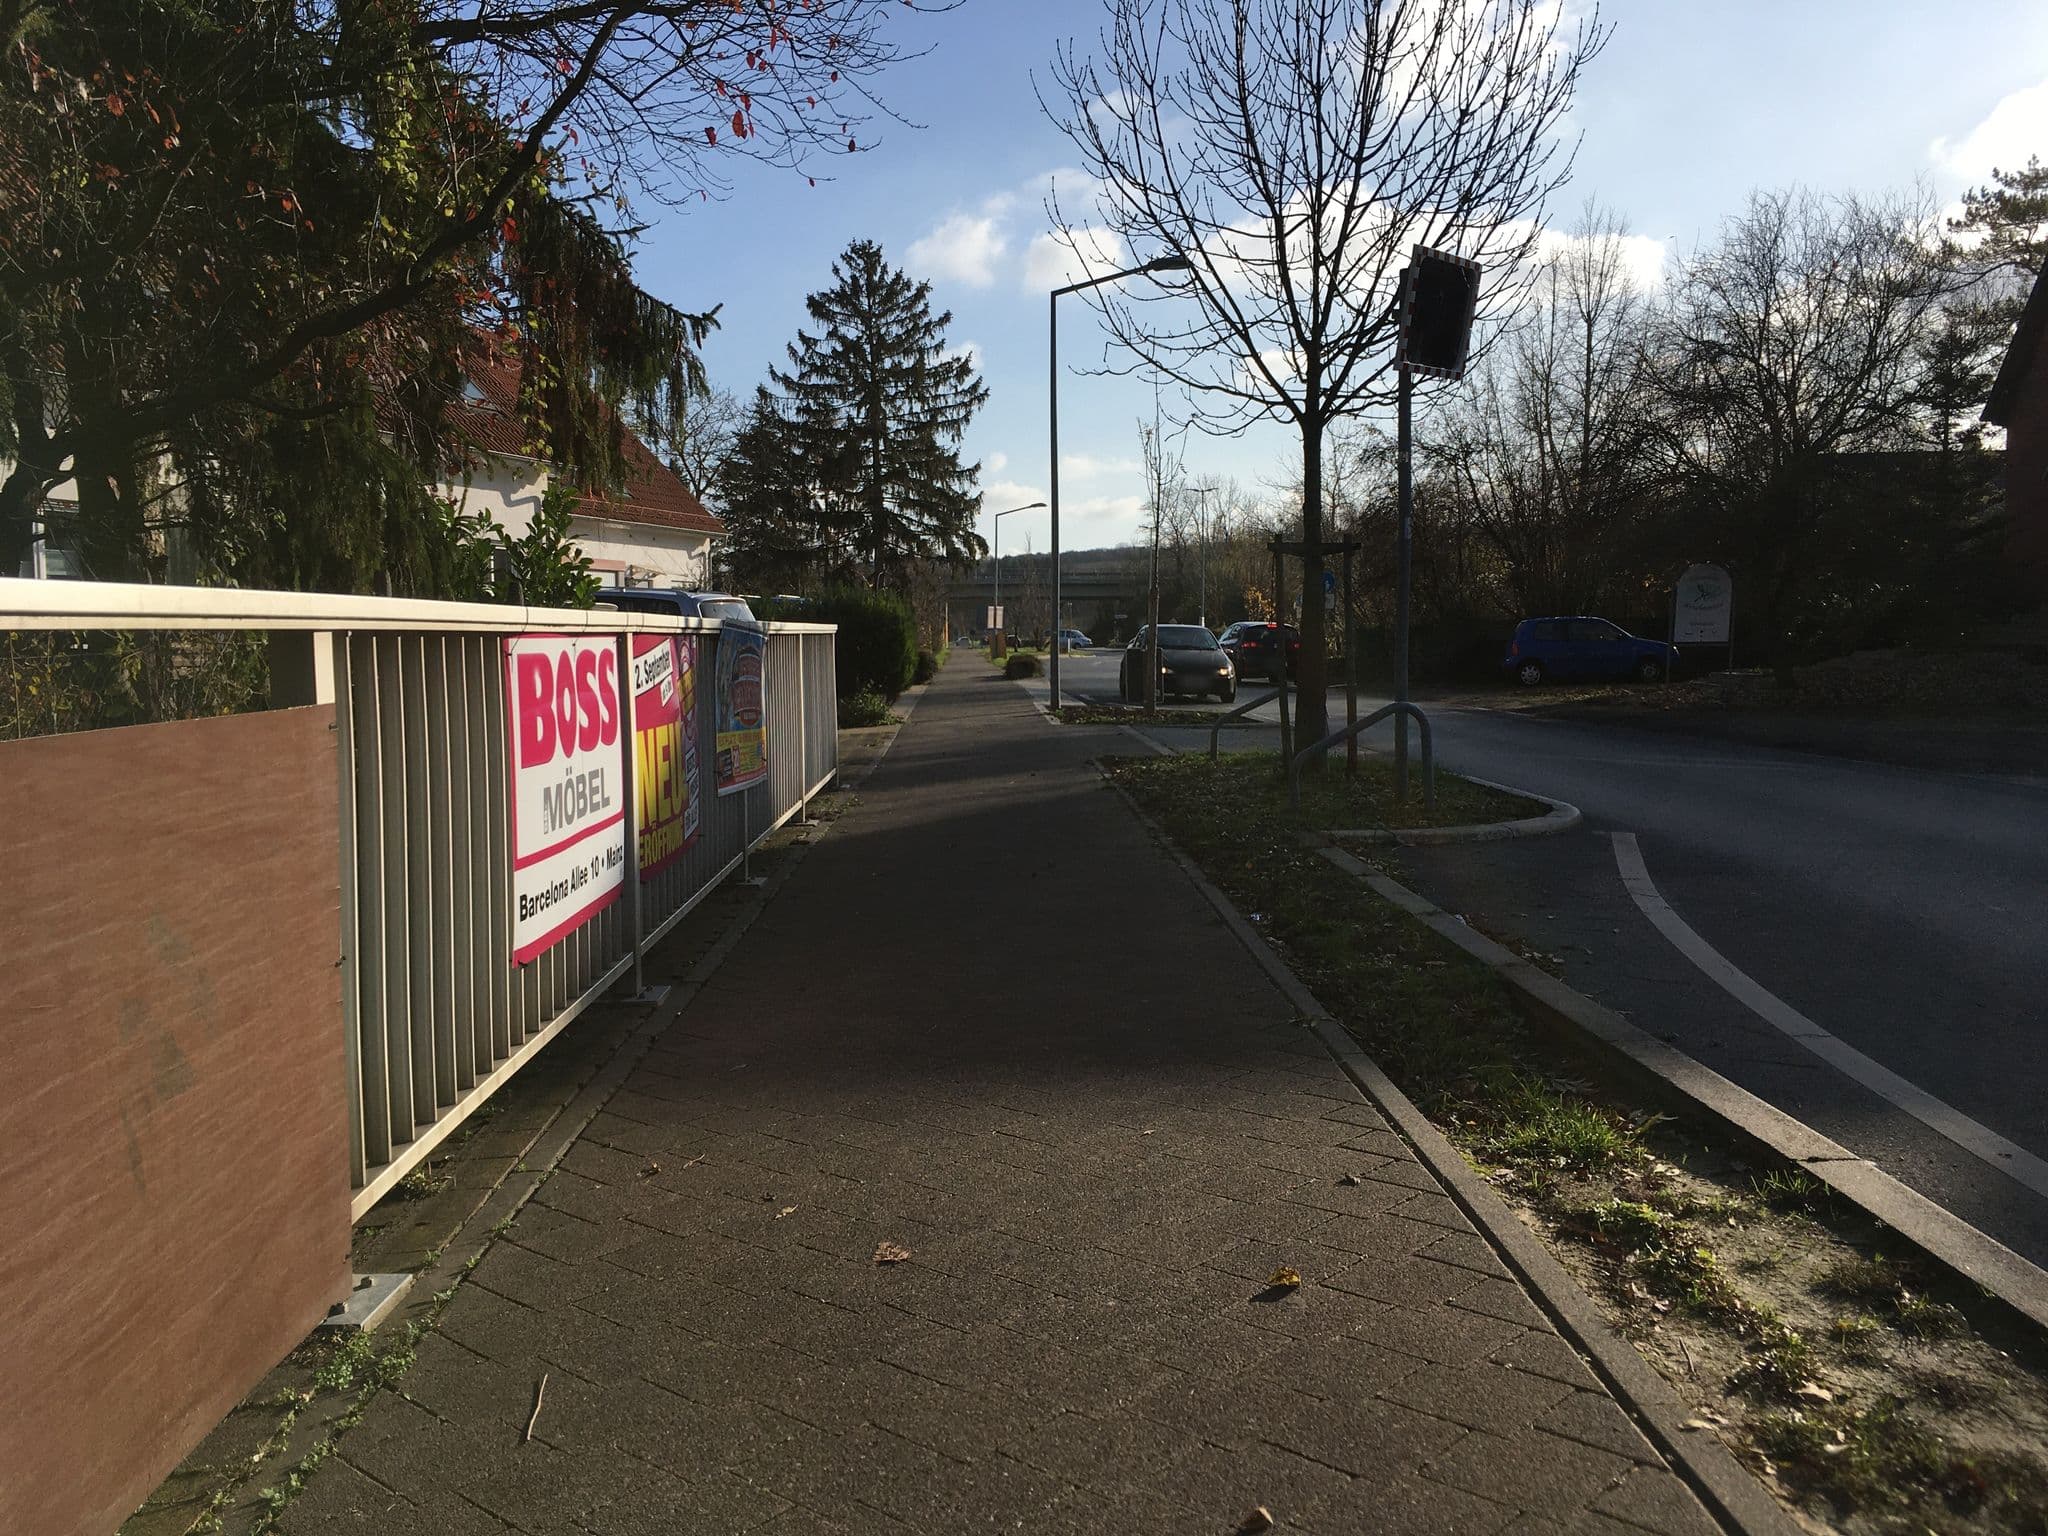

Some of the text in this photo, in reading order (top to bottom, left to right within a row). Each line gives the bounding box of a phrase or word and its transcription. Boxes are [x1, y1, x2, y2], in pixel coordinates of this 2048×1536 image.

[635, 665, 644, 689] 2.
[644, 649, 670, 685] September
[517, 648, 618, 769] BOSS
[543, 766, 611, 835] MÖBEL
[637, 721, 683, 831] NEU
[519, 880, 569, 922] Barcelona
[571, 865, 588, 893] Allee
[591, 855, 600, 879] 10
[606, 844, 623, 870] Mainz
